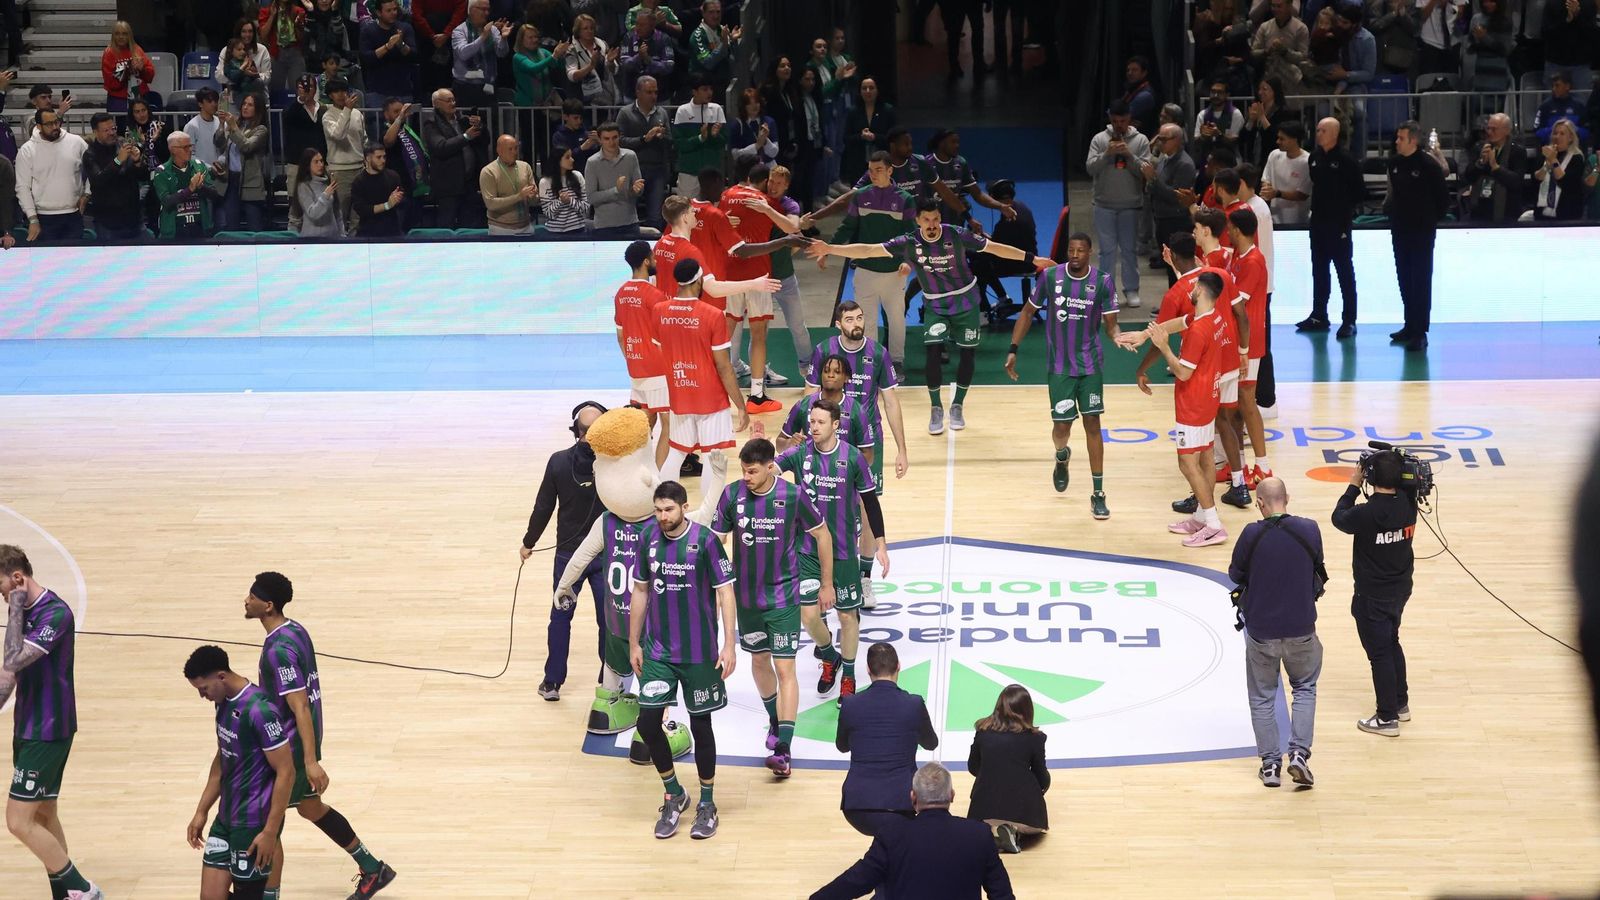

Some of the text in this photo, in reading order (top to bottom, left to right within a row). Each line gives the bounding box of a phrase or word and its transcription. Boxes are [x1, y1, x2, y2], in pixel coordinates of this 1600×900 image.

[674, 379, 700, 388] LOBAL
[751, 517, 785, 525] Fundación
[751, 522, 776, 531] Unicaja
[661, 561, 696, 570] Fundación
[661, 568, 686, 578] Unicaja
[873, 582, 1158, 597] Balonce
[860, 601, 1092, 621] Unica
